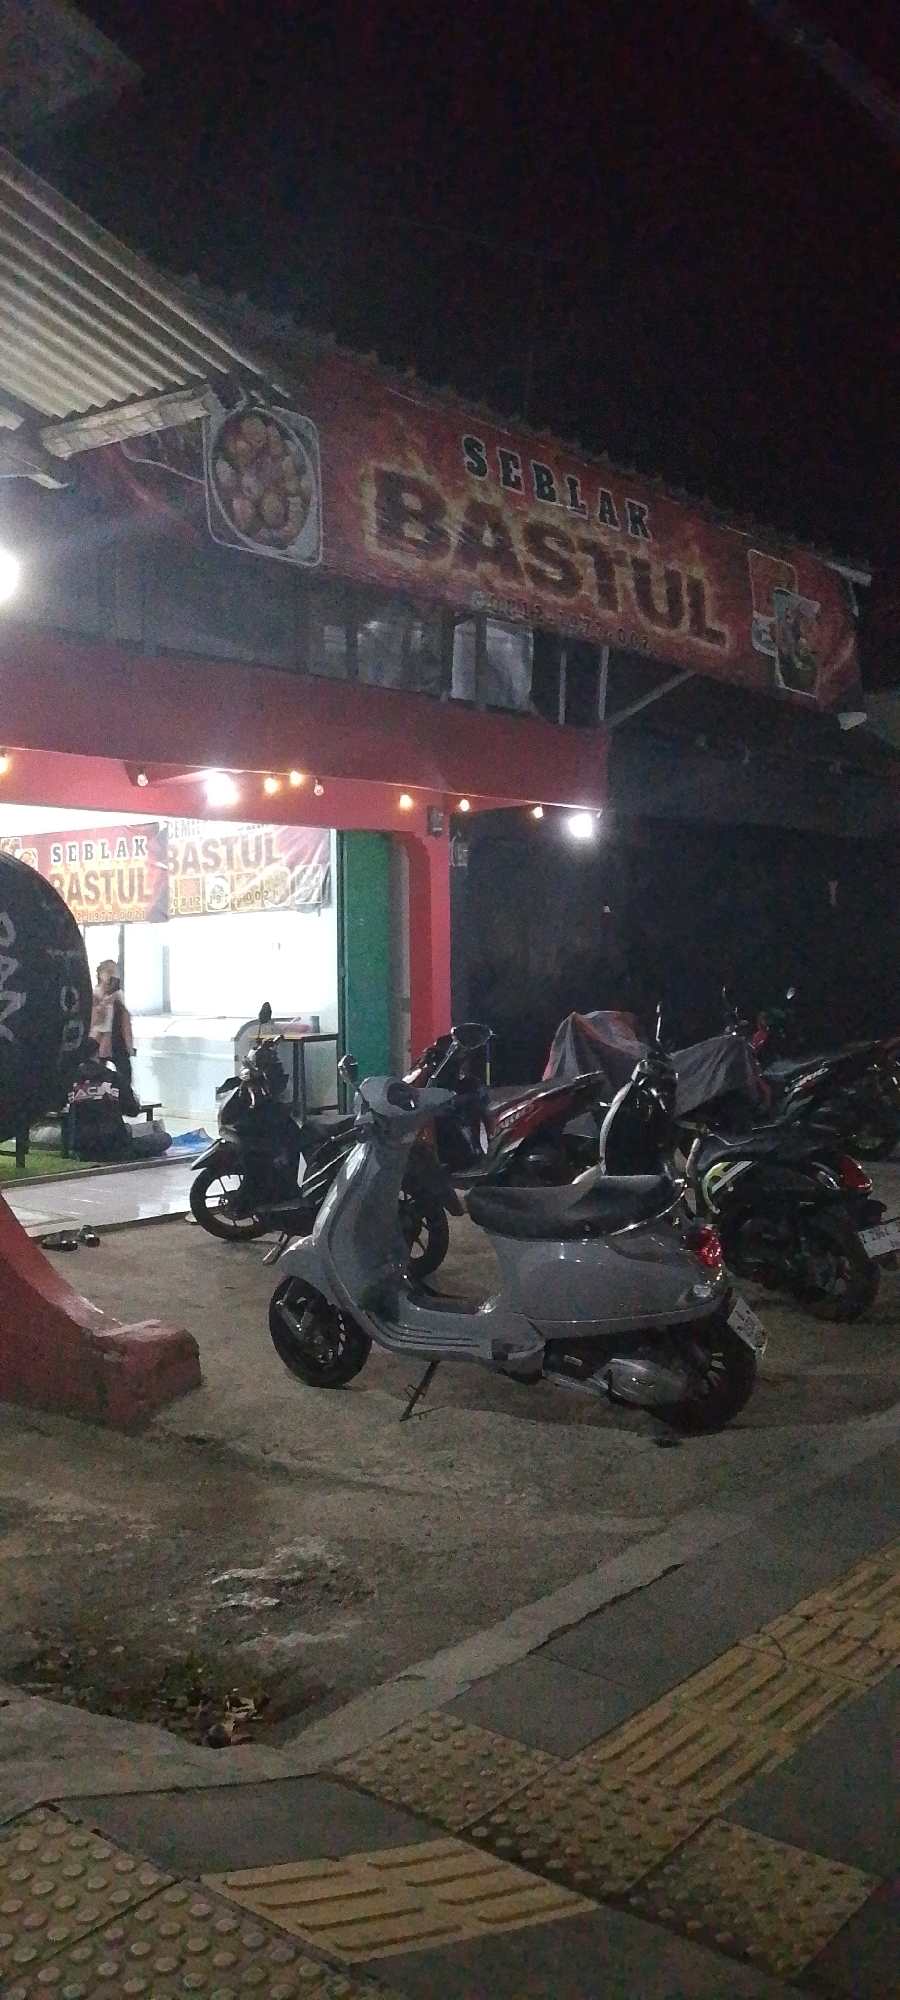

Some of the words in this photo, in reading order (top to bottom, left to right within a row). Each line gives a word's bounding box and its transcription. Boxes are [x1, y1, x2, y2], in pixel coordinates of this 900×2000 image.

[463, 435, 651, 541] SEBLAK
[372, 464, 728, 649] BASTUL
[52, 838, 147, 863] SEBLAK
[168, 832, 282, 877] BASTUL
[50, 867, 151, 907] BASTUL
[76, 911, 147, 922] 2-1977-0021
